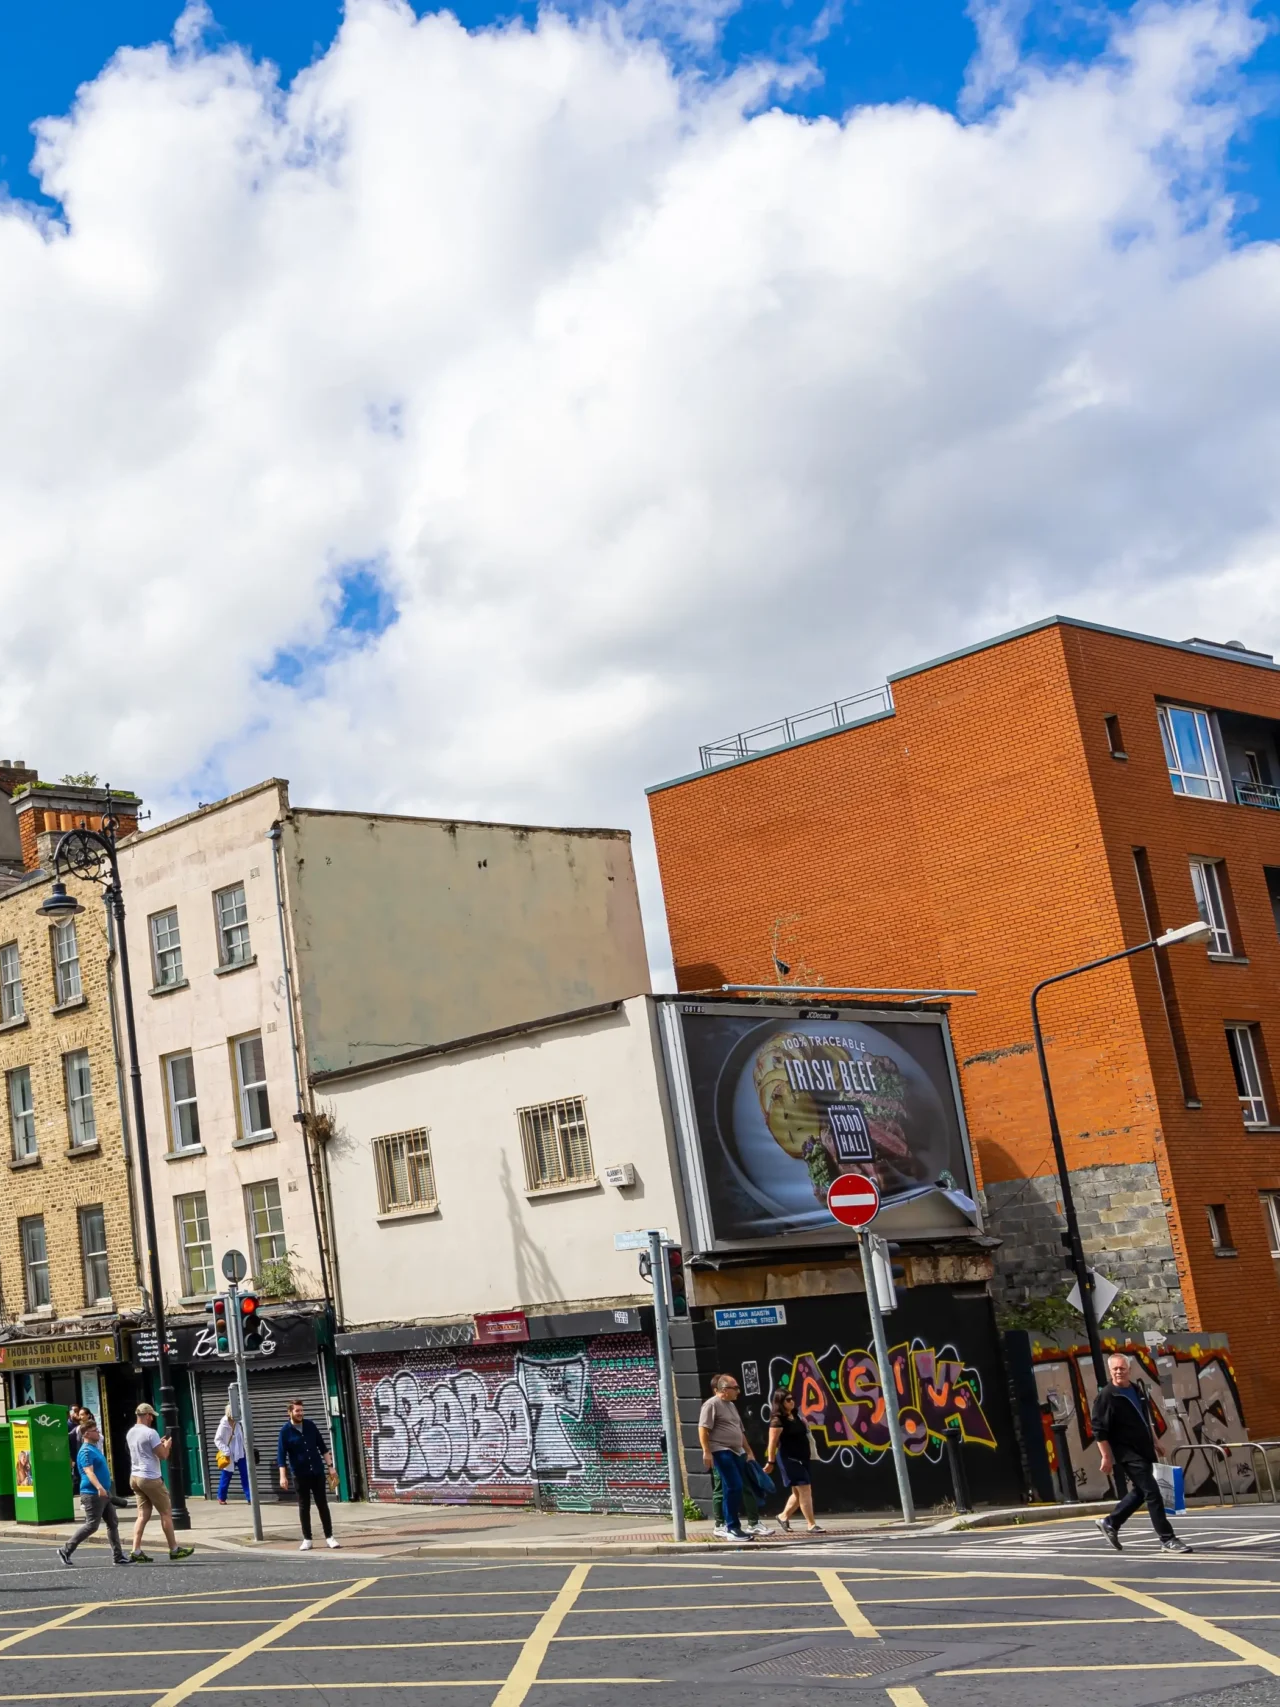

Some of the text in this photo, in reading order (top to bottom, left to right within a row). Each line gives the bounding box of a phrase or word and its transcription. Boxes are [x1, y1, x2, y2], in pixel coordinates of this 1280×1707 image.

[806, 1011, 832, 1020] JCDecaux
[781, 1035, 867, 1052] 100% TRACEABLE
[784, 1059, 878, 1092] IRISH BEEF
[834, 1113, 862, 1132] FOOD
[839, 1134, 867, 1153] HALL
[734, 1318, 758, 1326] AUGUSTINE
[7, 1340, 101, 1358] THOMAS DRY CLEANERS
[12, 1358, 28, 1367] SHOE
[29, 1357, 51, 1366] REPAIR
